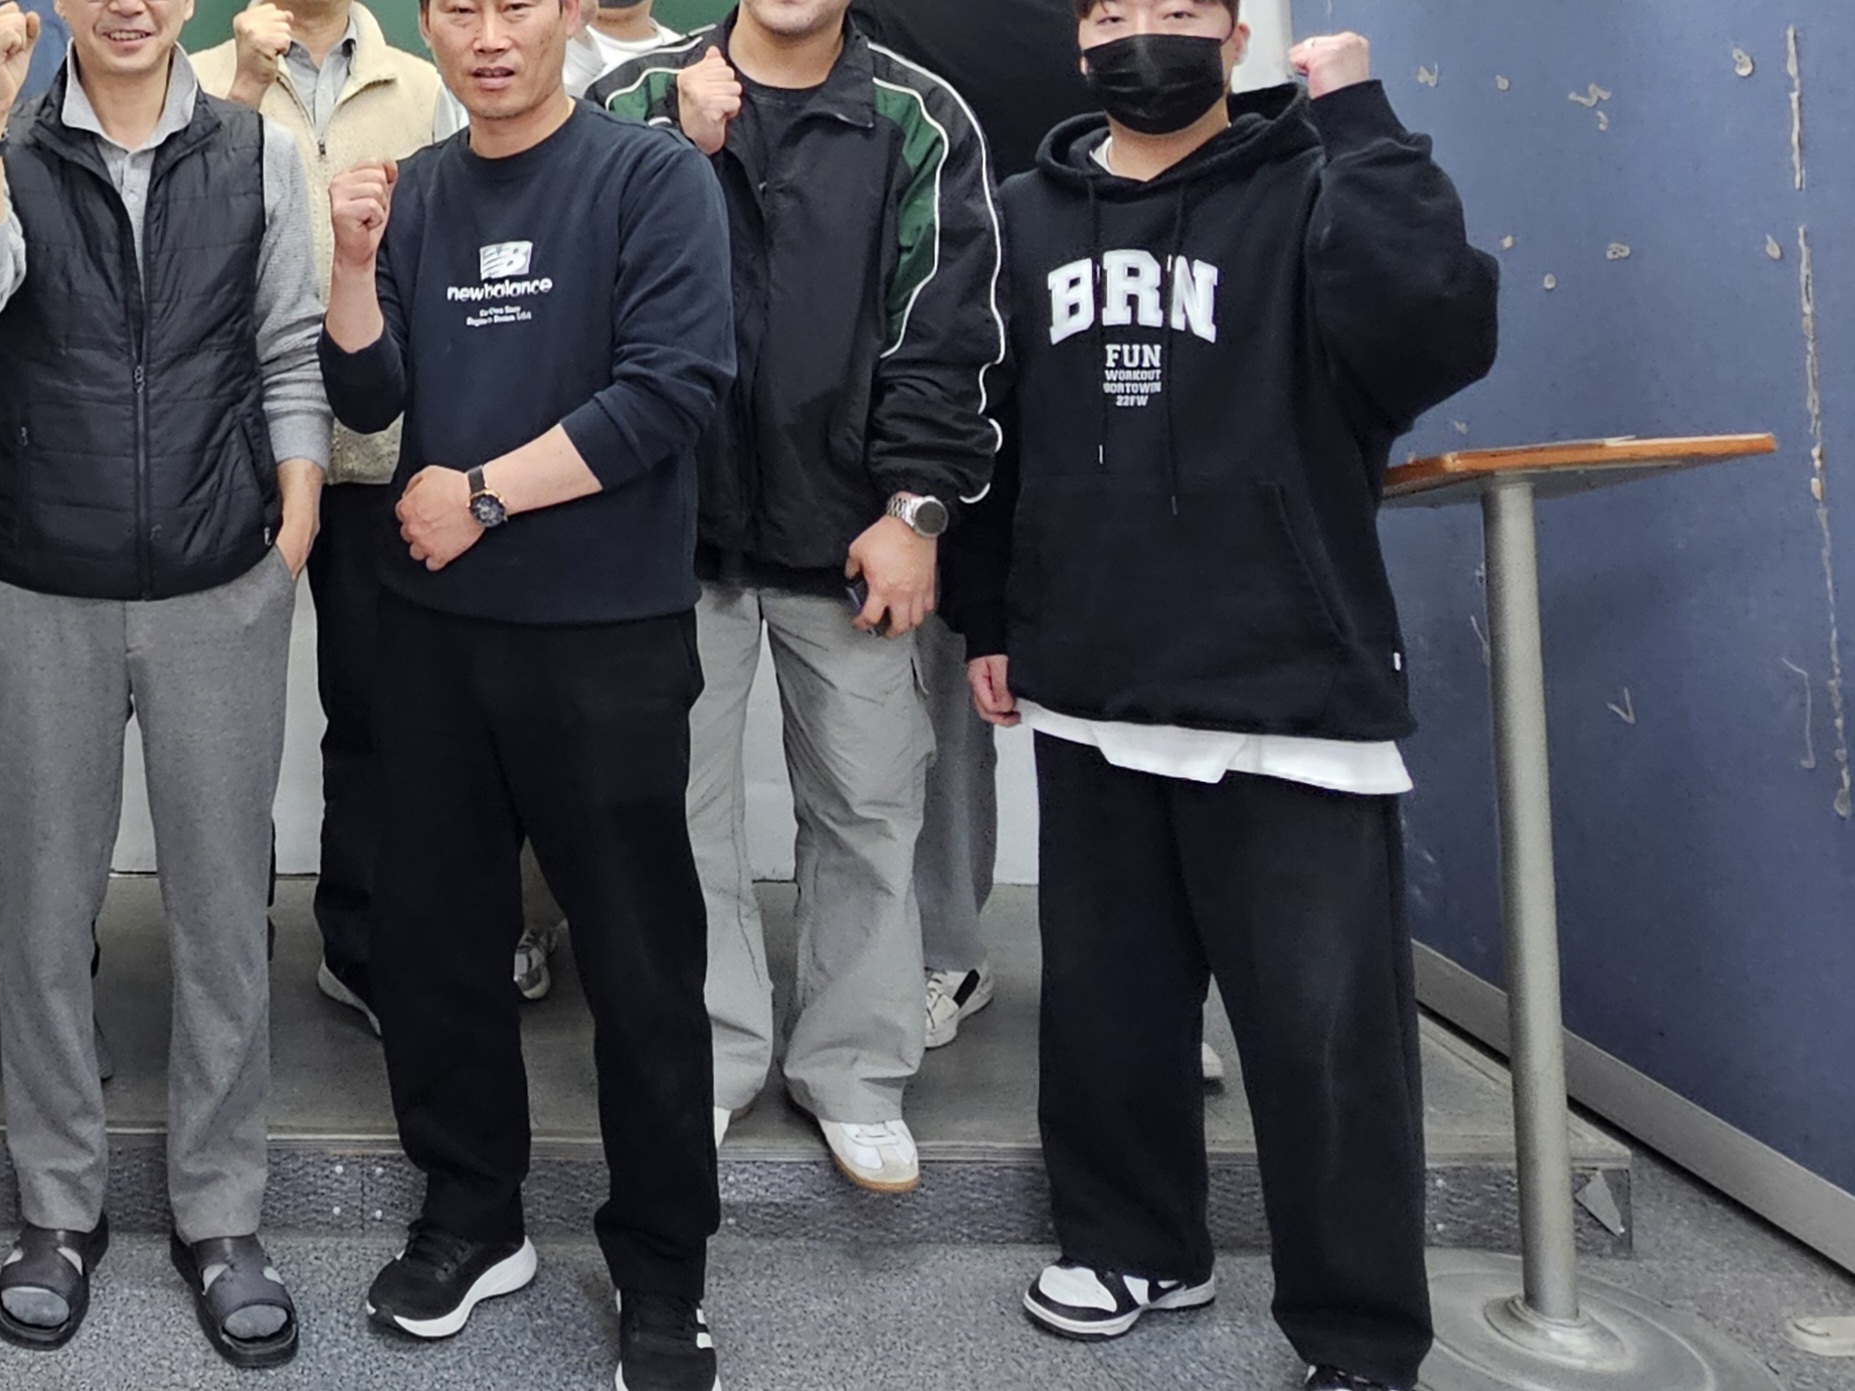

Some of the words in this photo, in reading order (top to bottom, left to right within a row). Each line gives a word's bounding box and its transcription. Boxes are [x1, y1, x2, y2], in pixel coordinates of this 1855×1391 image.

[1048, 249, 1219, 345] BRN
[1105, 344, 1162, 368] FUN
[1105, 369, 1162, 381] WORKOUT
